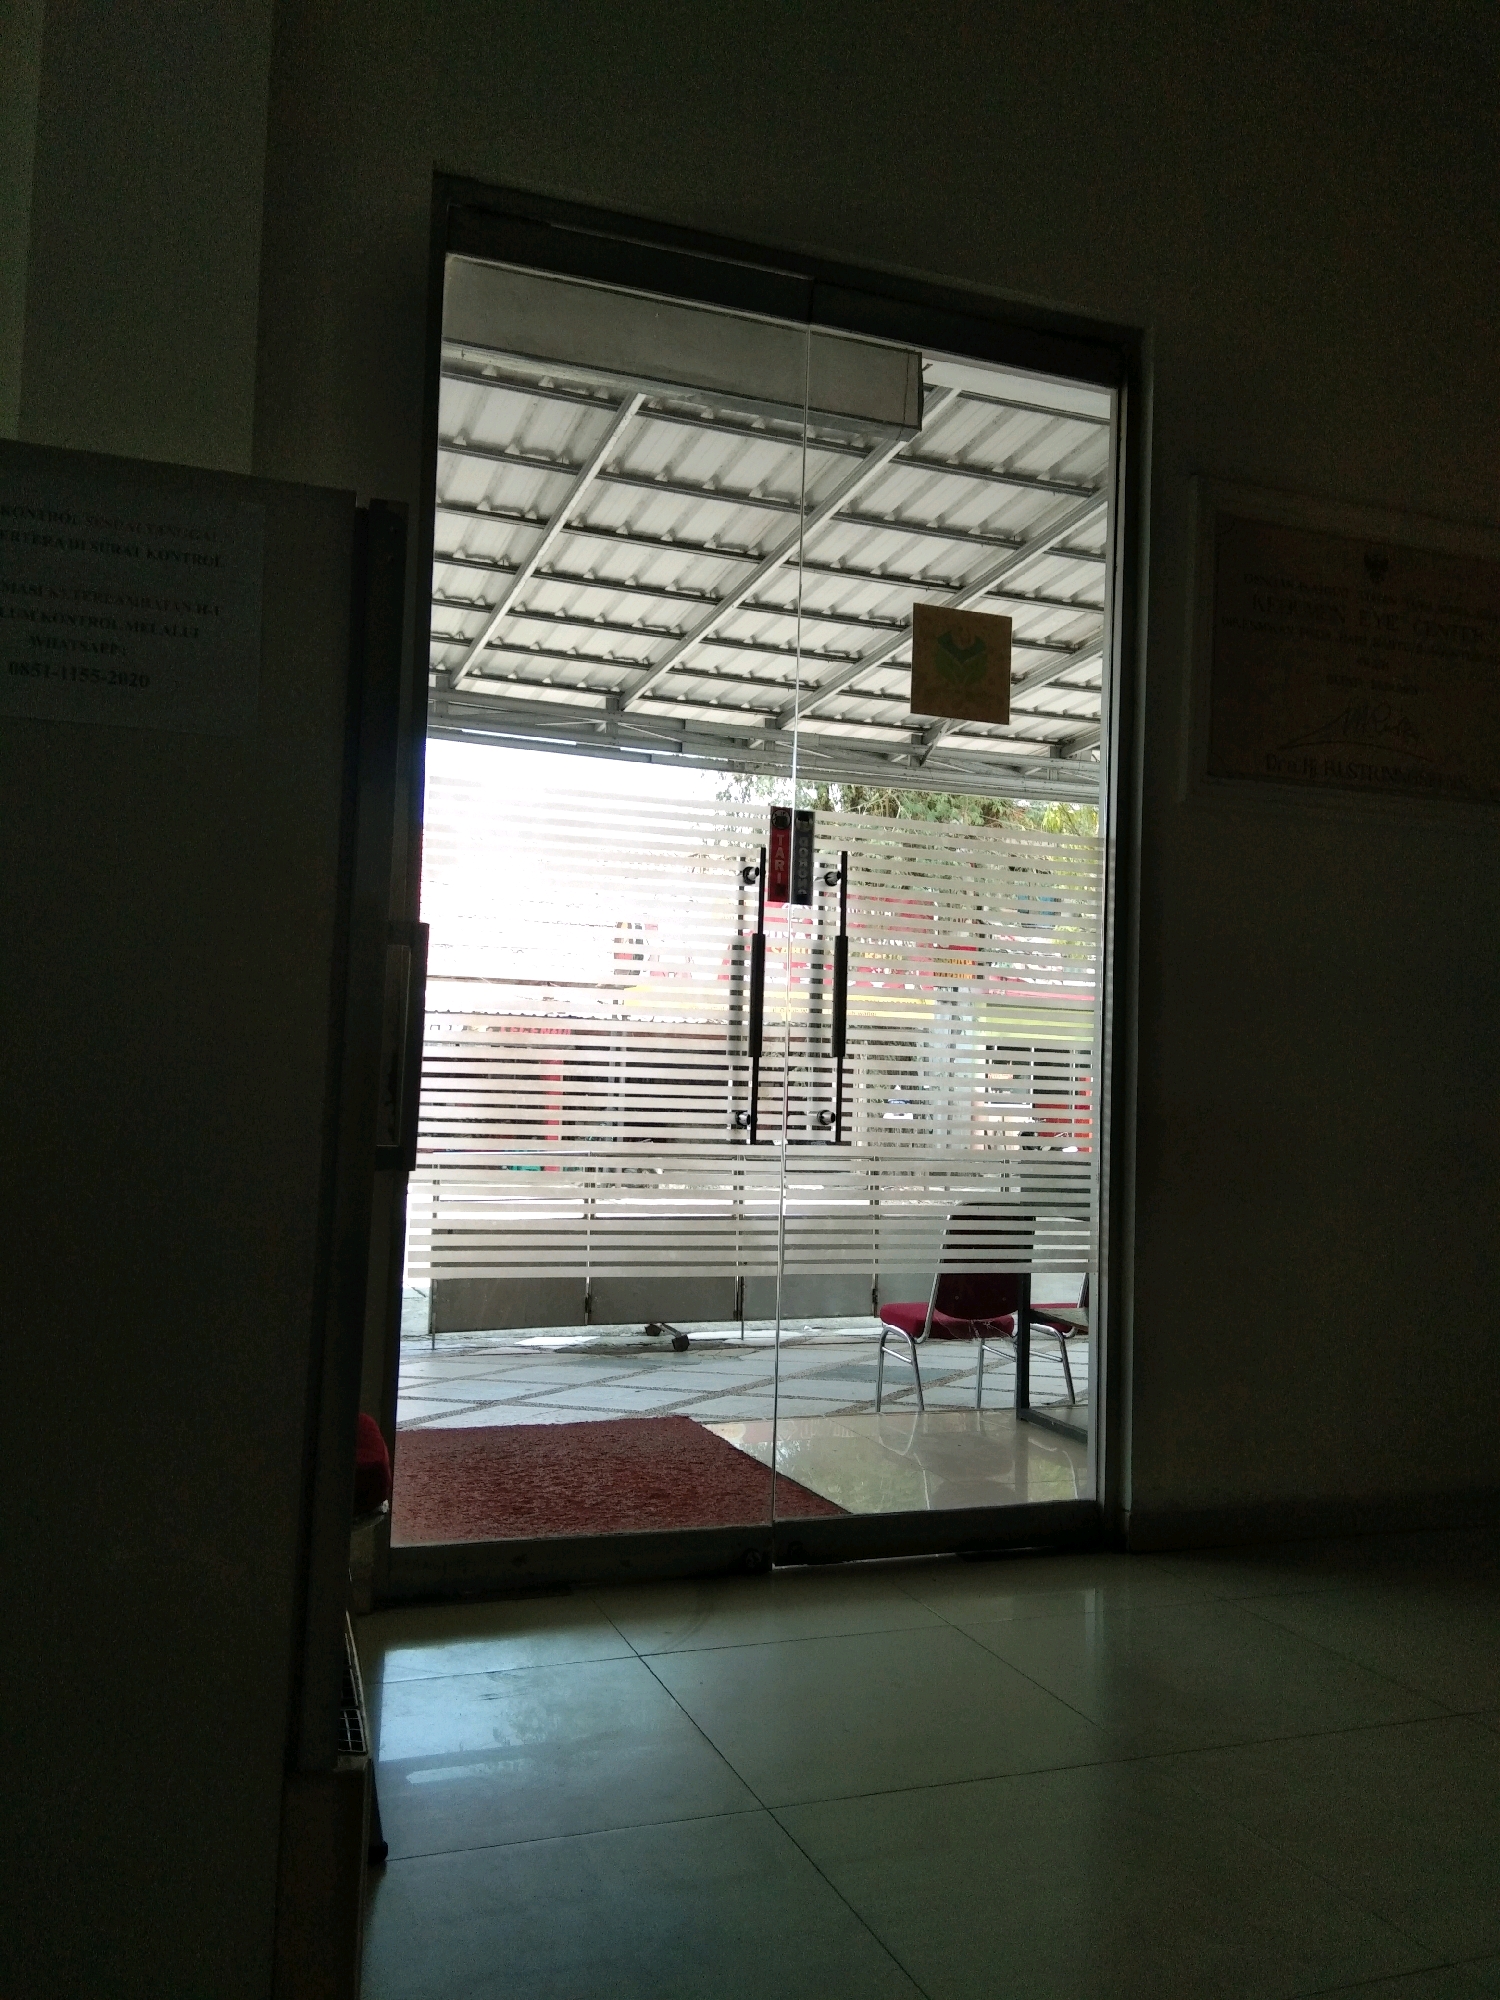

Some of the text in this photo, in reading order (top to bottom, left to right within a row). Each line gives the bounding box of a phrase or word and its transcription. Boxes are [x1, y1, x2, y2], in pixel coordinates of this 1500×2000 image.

[90, 539, 141, 559] SURAT
[146, 547, 223, 569] KONTROL
[40, 610, 123, 632] KONTROL
[8, 660, 151, 689] 0851-1155-2020
[774, 833, 786, 896] TARI
